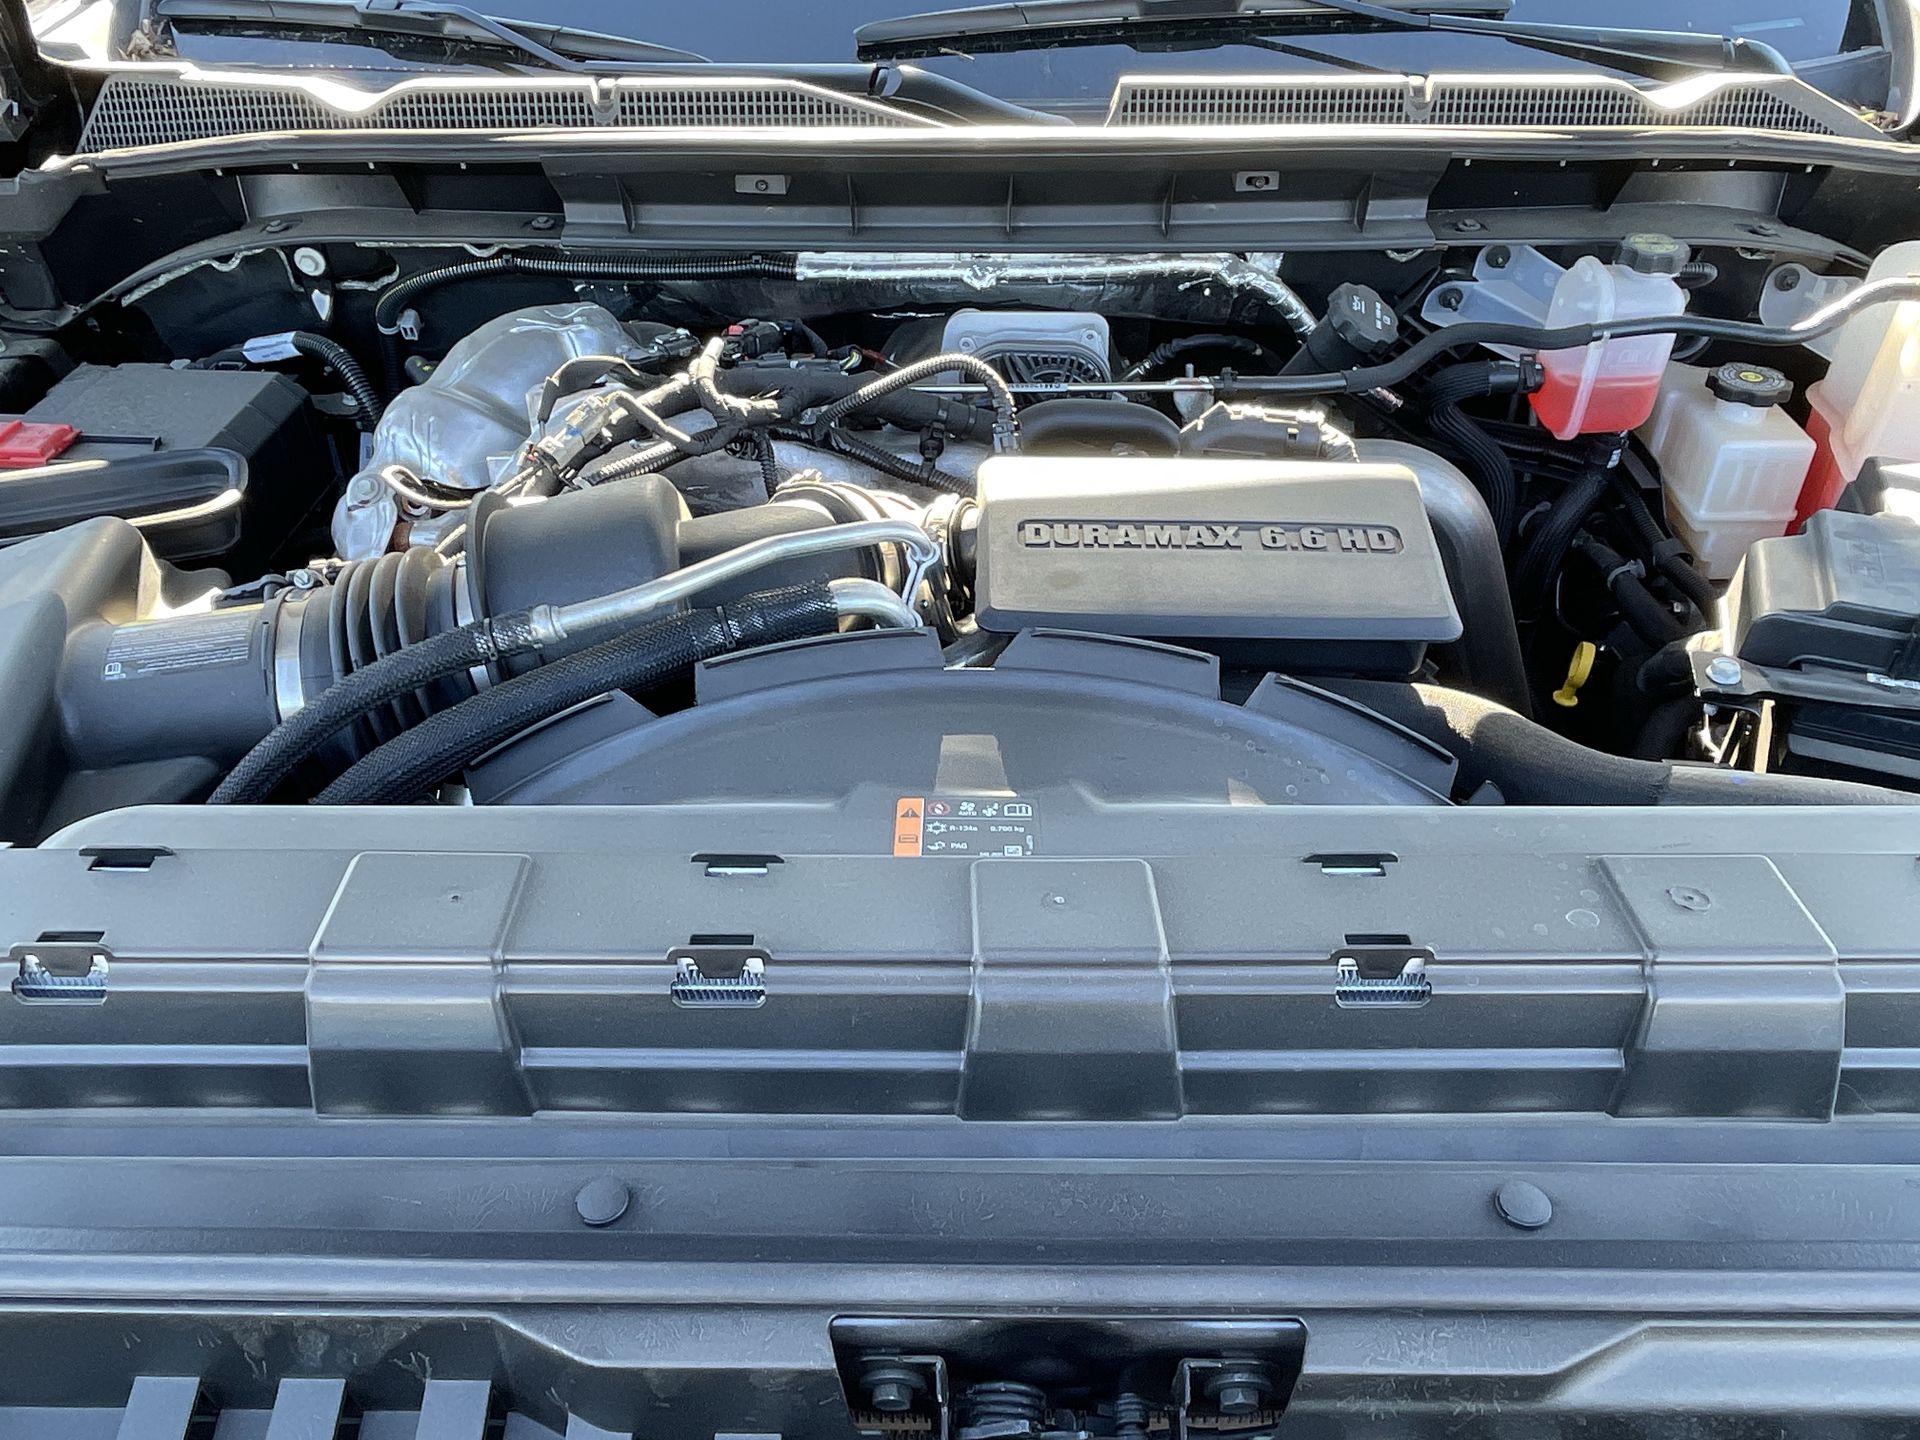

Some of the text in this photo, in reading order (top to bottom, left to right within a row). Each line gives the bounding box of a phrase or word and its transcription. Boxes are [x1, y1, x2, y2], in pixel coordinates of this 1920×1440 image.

[1023, 523, 1397, 552] DURAMAX 6.6 HD
